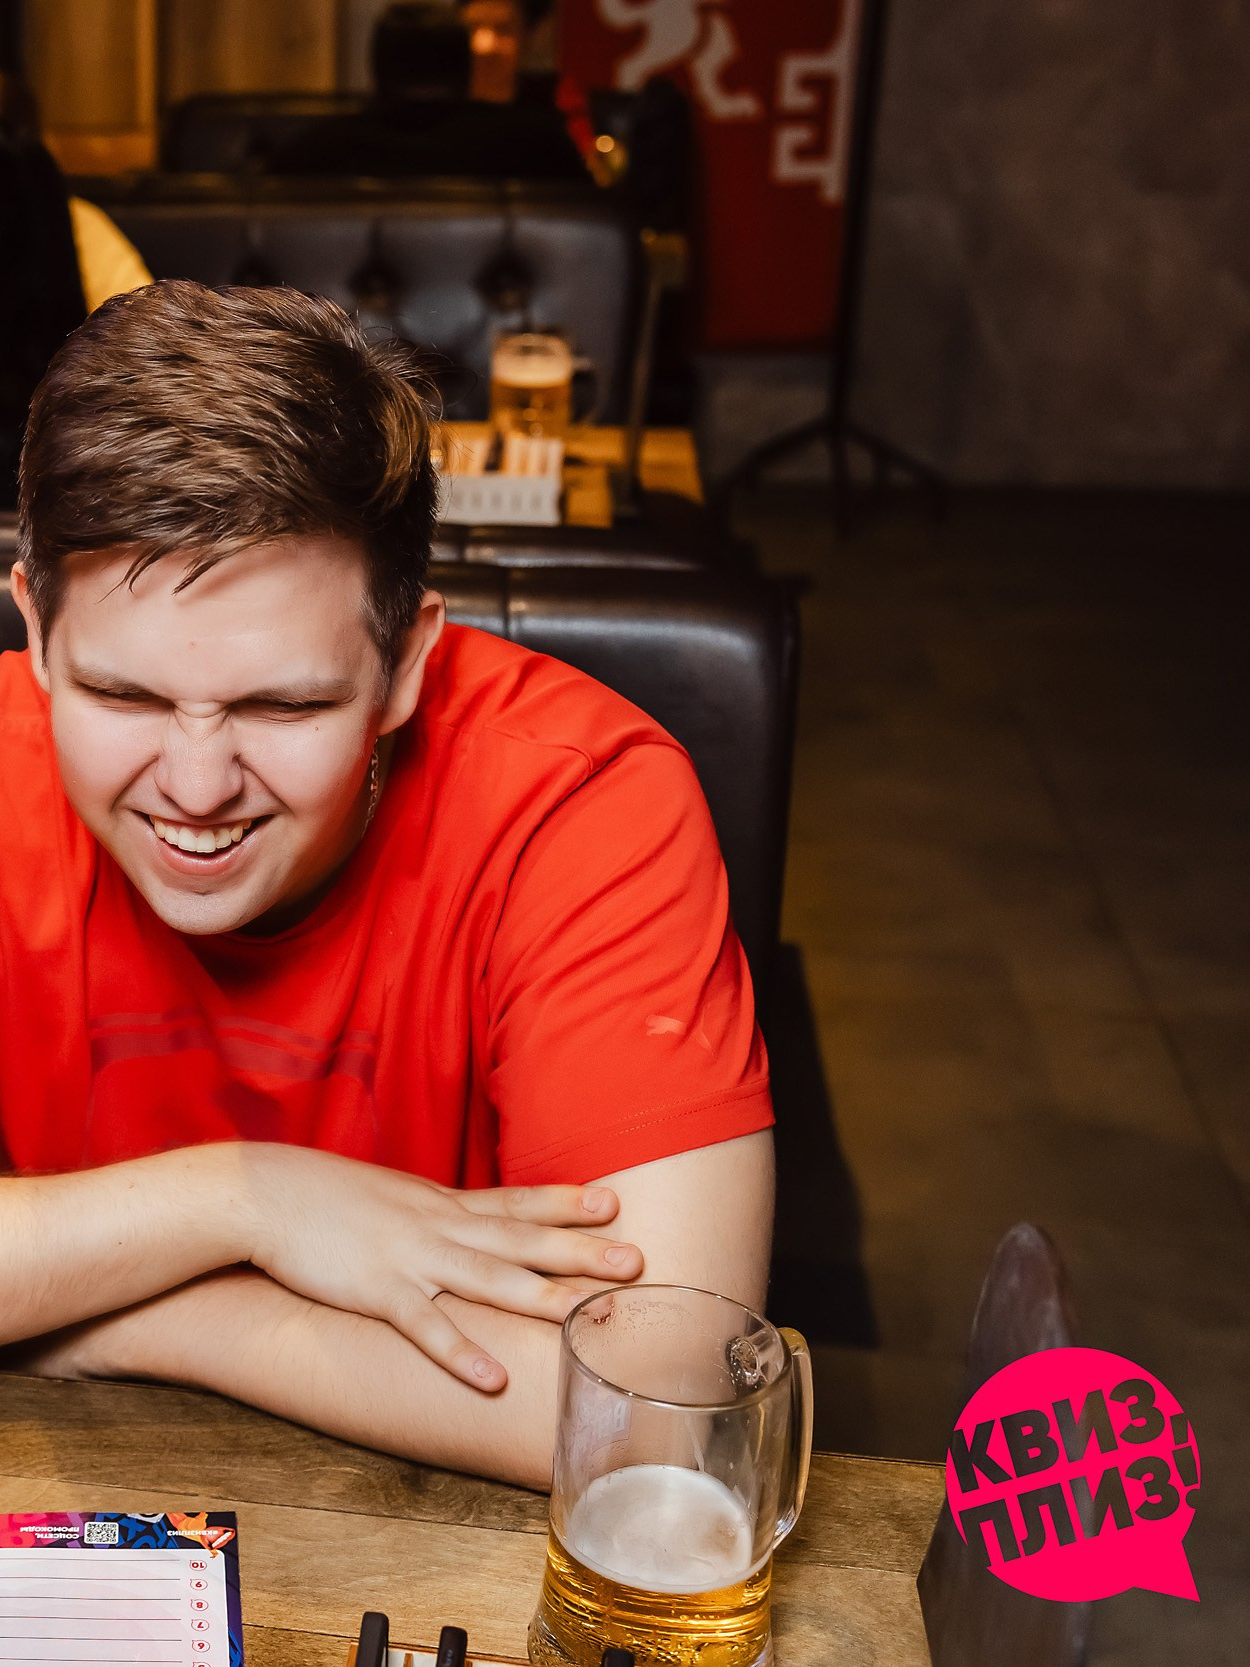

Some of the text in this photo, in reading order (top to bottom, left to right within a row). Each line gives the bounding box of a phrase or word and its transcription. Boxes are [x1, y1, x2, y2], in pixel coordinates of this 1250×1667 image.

[196, 1601, 203, 1609] 8
[197, 1621, 204, 1629] 7
[197, 1642, 205, 1650] 6
